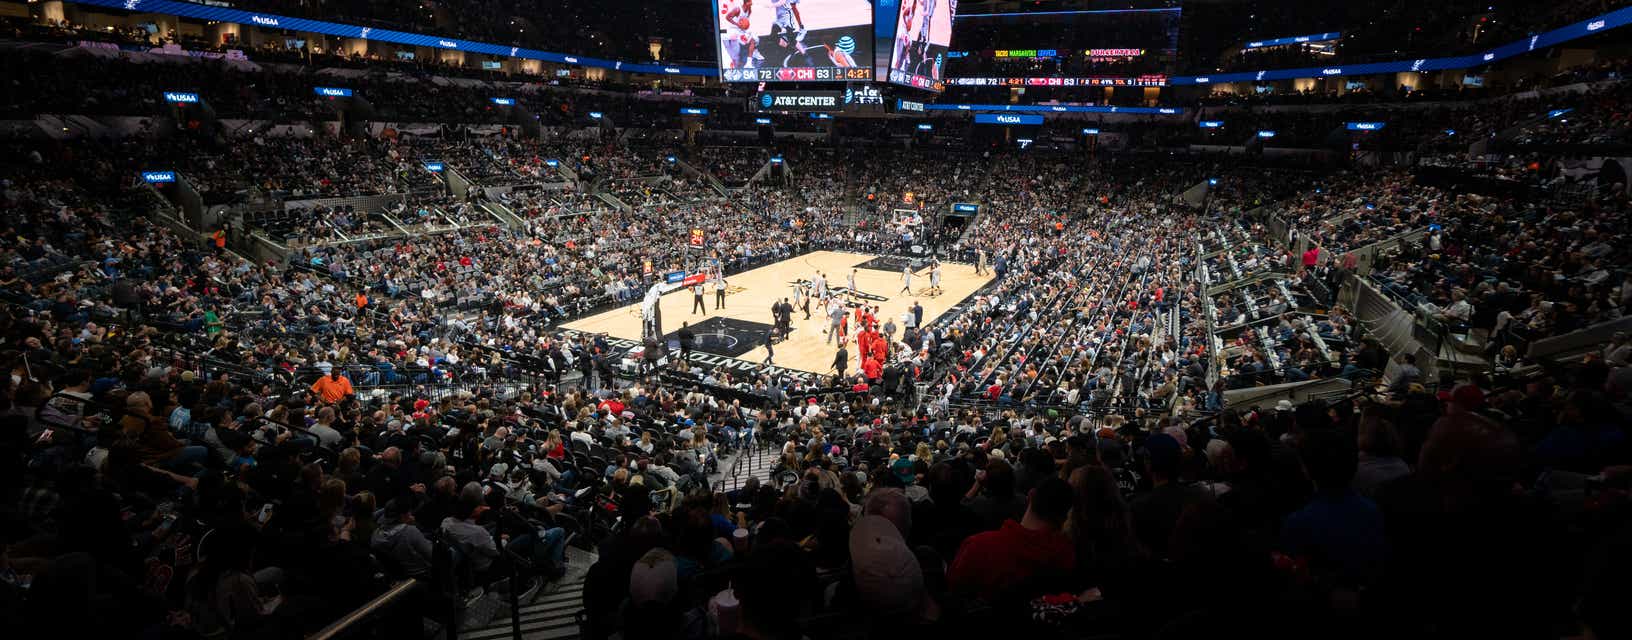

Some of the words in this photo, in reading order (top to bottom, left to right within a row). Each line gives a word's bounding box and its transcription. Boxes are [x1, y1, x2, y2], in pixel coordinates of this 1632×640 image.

[261, 17, 278, 26] USAA
[743, 70, 756, 79] SA
[760, 70, 772, 79] 72
[797, 70, 813, 79] CHI
[817, 70, 829, 79] 63
[847, 69, 871, 79] 4:21
[177, 94, 195, 102] USAA
[774, 97, 797, 106] AT&T
[798, 97, 836, 106] CENTER
[691, 235, 704, 245] 24
